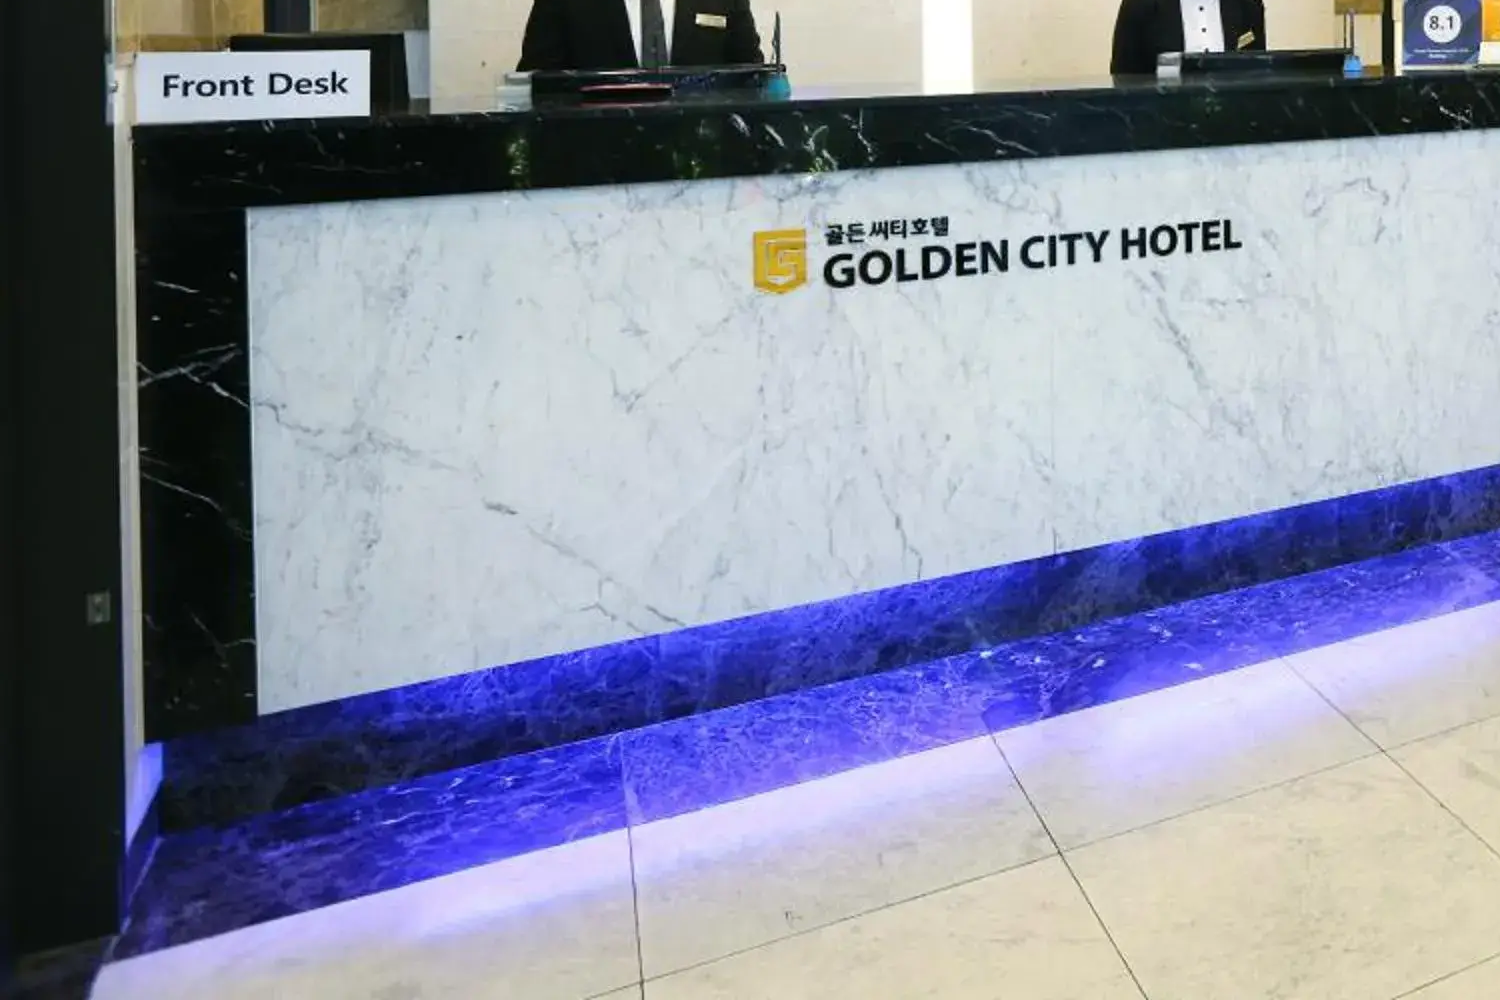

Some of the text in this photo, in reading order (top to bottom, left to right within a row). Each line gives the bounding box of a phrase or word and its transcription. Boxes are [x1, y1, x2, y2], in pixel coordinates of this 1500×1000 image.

[1429, 15, 1454, 31] 8.1
[162, 70, 350, 98] Front Desk
[823, 219, 1243, 289] GOLDEN CITY HOTEL
